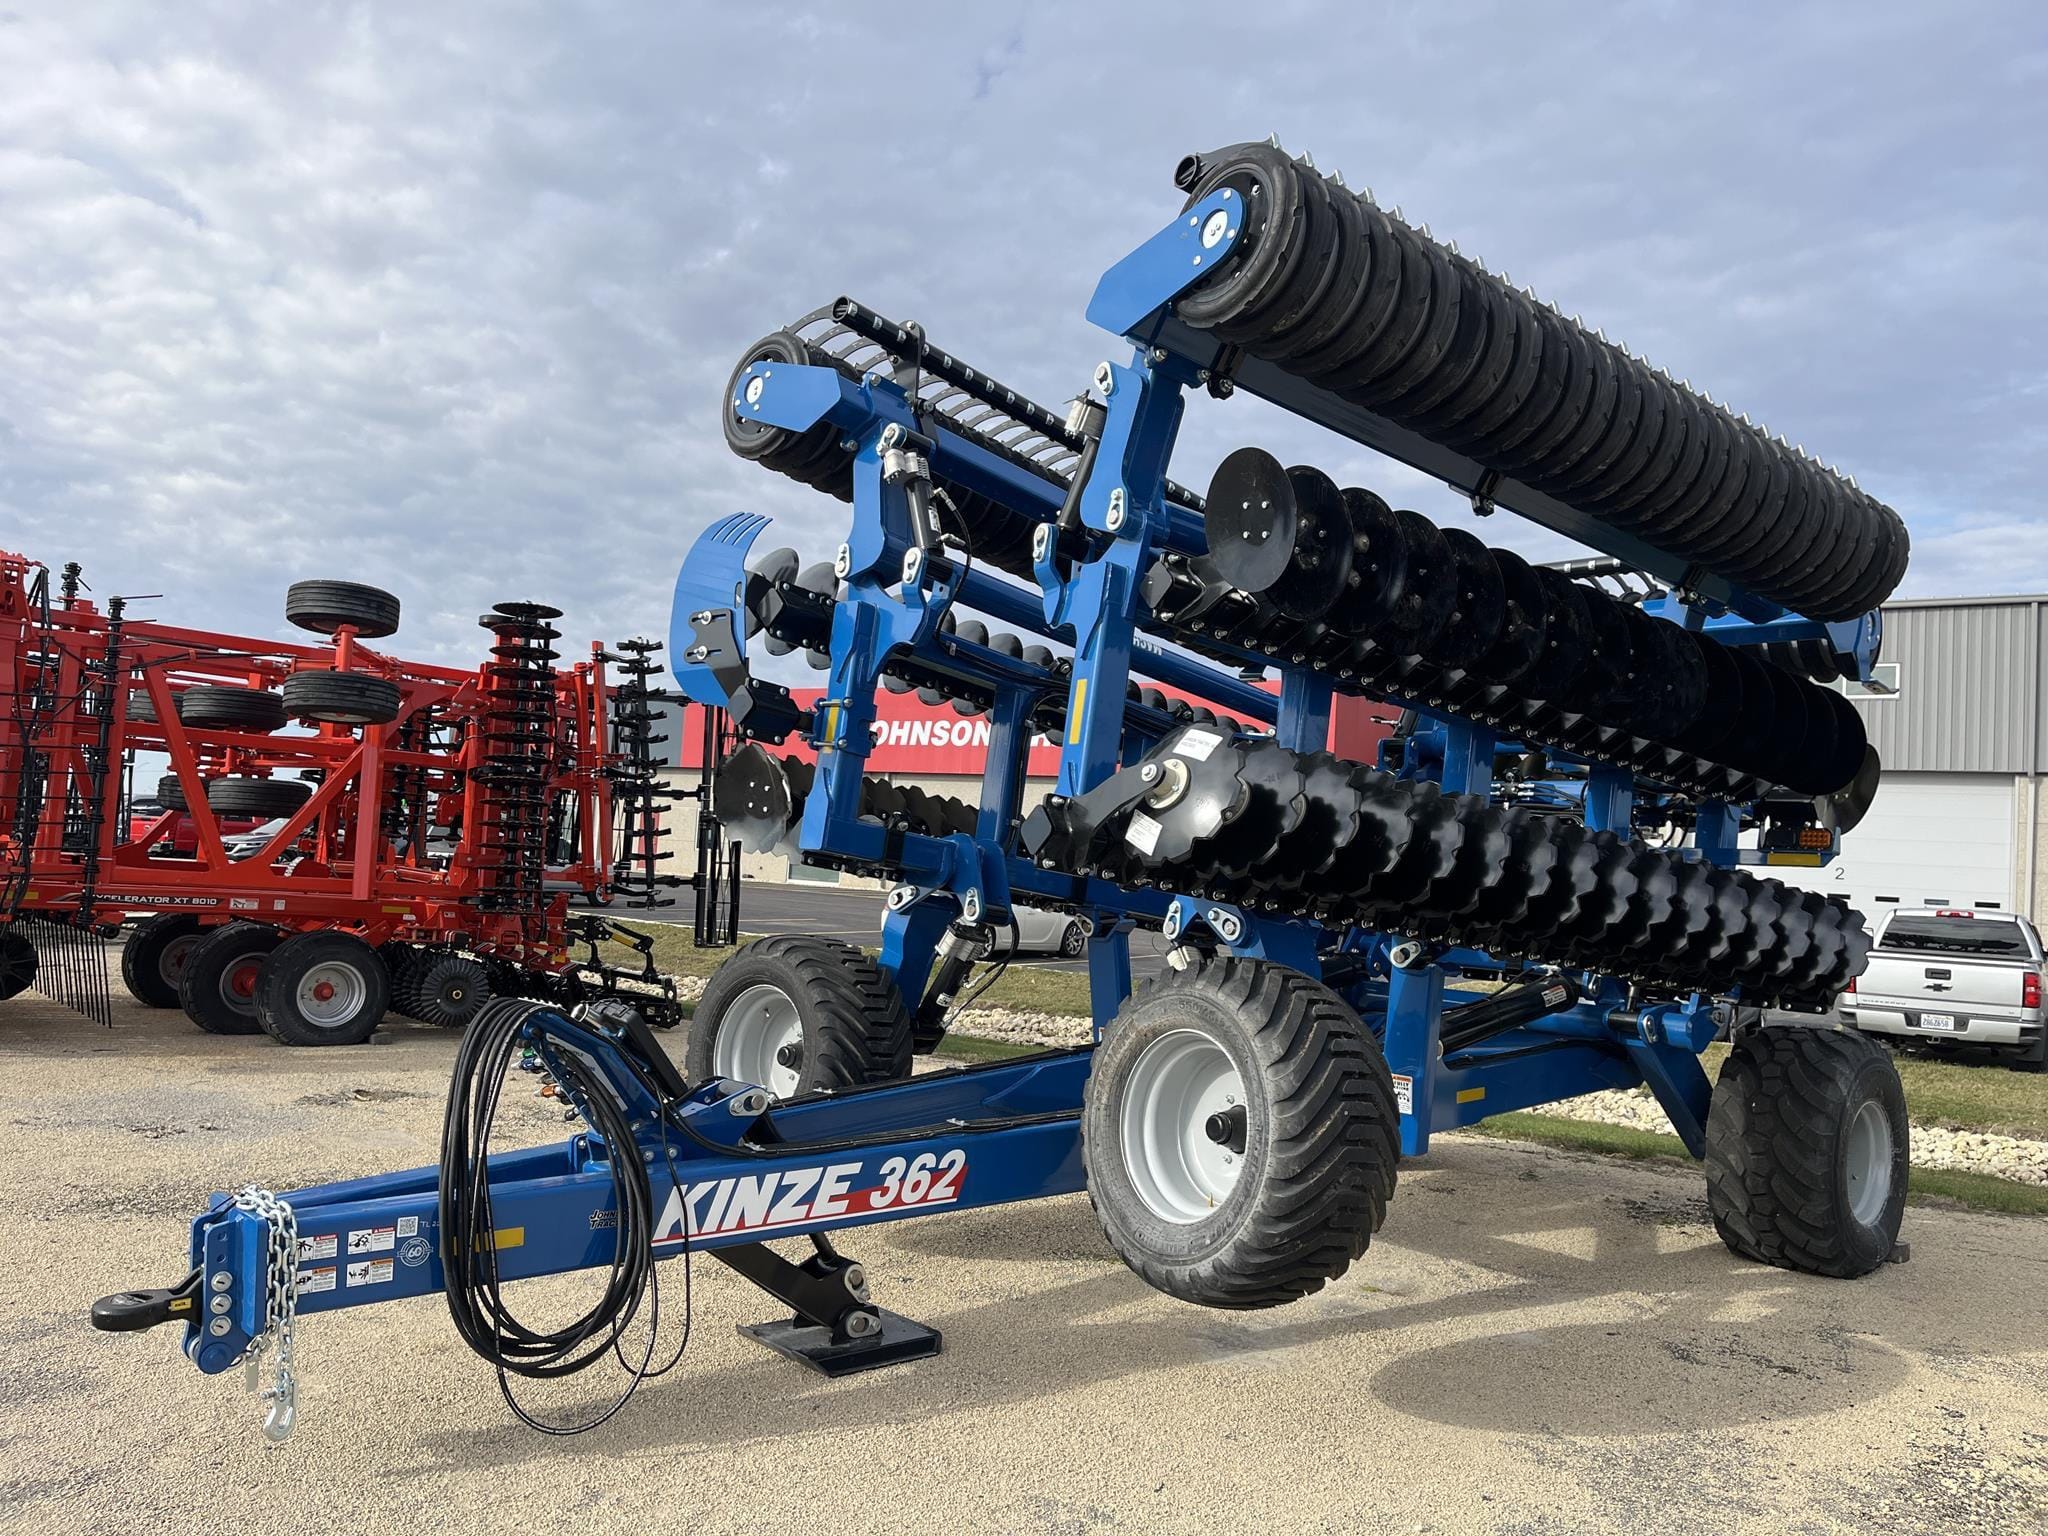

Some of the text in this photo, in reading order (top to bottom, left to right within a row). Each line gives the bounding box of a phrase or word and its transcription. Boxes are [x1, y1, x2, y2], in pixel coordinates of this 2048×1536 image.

[869, 720, 991, 747] OHNSON
[1834, 867, 1845, 880] 2
[652, 1149, 967, 1241] KINZE 362
